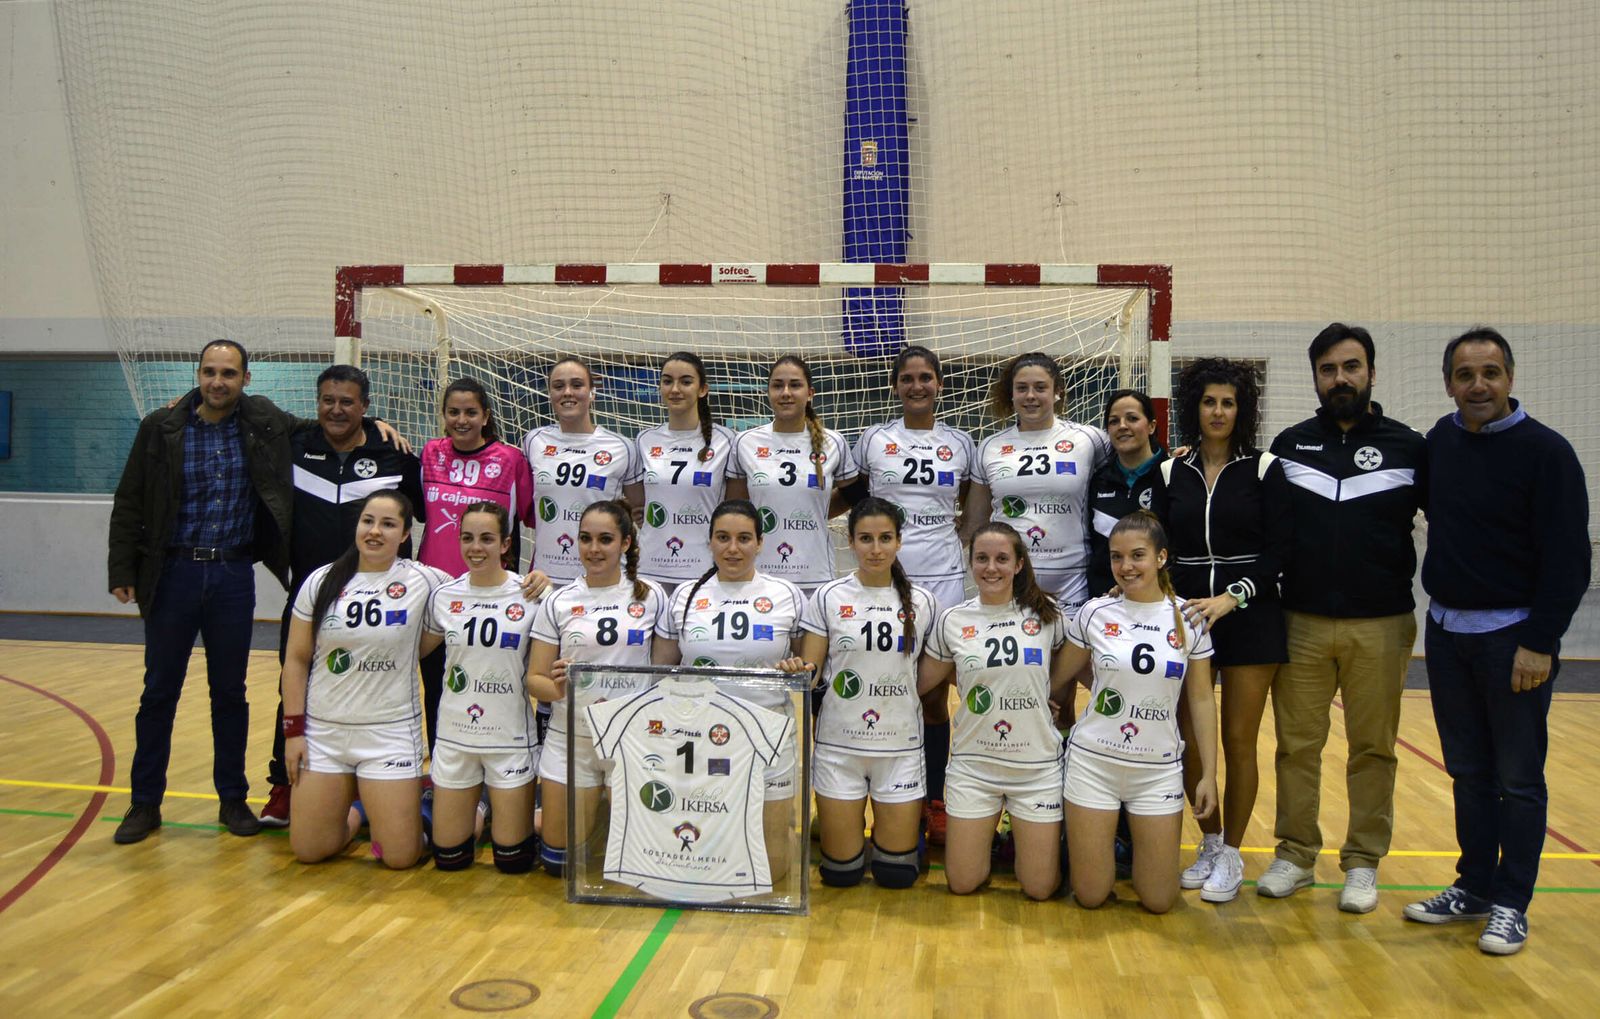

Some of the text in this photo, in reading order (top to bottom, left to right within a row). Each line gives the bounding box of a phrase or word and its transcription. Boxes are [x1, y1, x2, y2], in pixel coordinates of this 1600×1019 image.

[719, 267, 749, 275] Softee
[449, 459, 481, 486] 39
[555, 462, 587, 487] 99
[670, 460, 688, 485] 7
[778, 461, 797, 487] 3
[902, 458, 935, 485] 25
[1016, 453, 1051, 477] 23
[673, 513, 710, 525] IKERSA
[913, 514, 948, 526] IKERSA
[1034, 503, 1072, 514] IKERSA
[783, 518, 819, 531] IKERSA
[345, 598, 382, 629] 96
[463, 616, 498, 648] 10
[595, 617, 619, 646] 8
[711, 611, 750, 641] 19
[860, 620, 893, 652] 18
[984, 635, 1019, 668] 29
[1131, 642, 1156, 675] 6
[357, 659, 397, 672] IKERSA
[473, 680, 514, 695] IKERSA
[600, 675, 636, 689] IKERSA
[868, 683, 909, 697] IKERSA
[1000, 696, 1040, 711] IKERSA
[1129, 704, 1170, 721] IKERSA
[676, 740, 695, 774] 1
[681, 797, 729, 813] IKERSA
